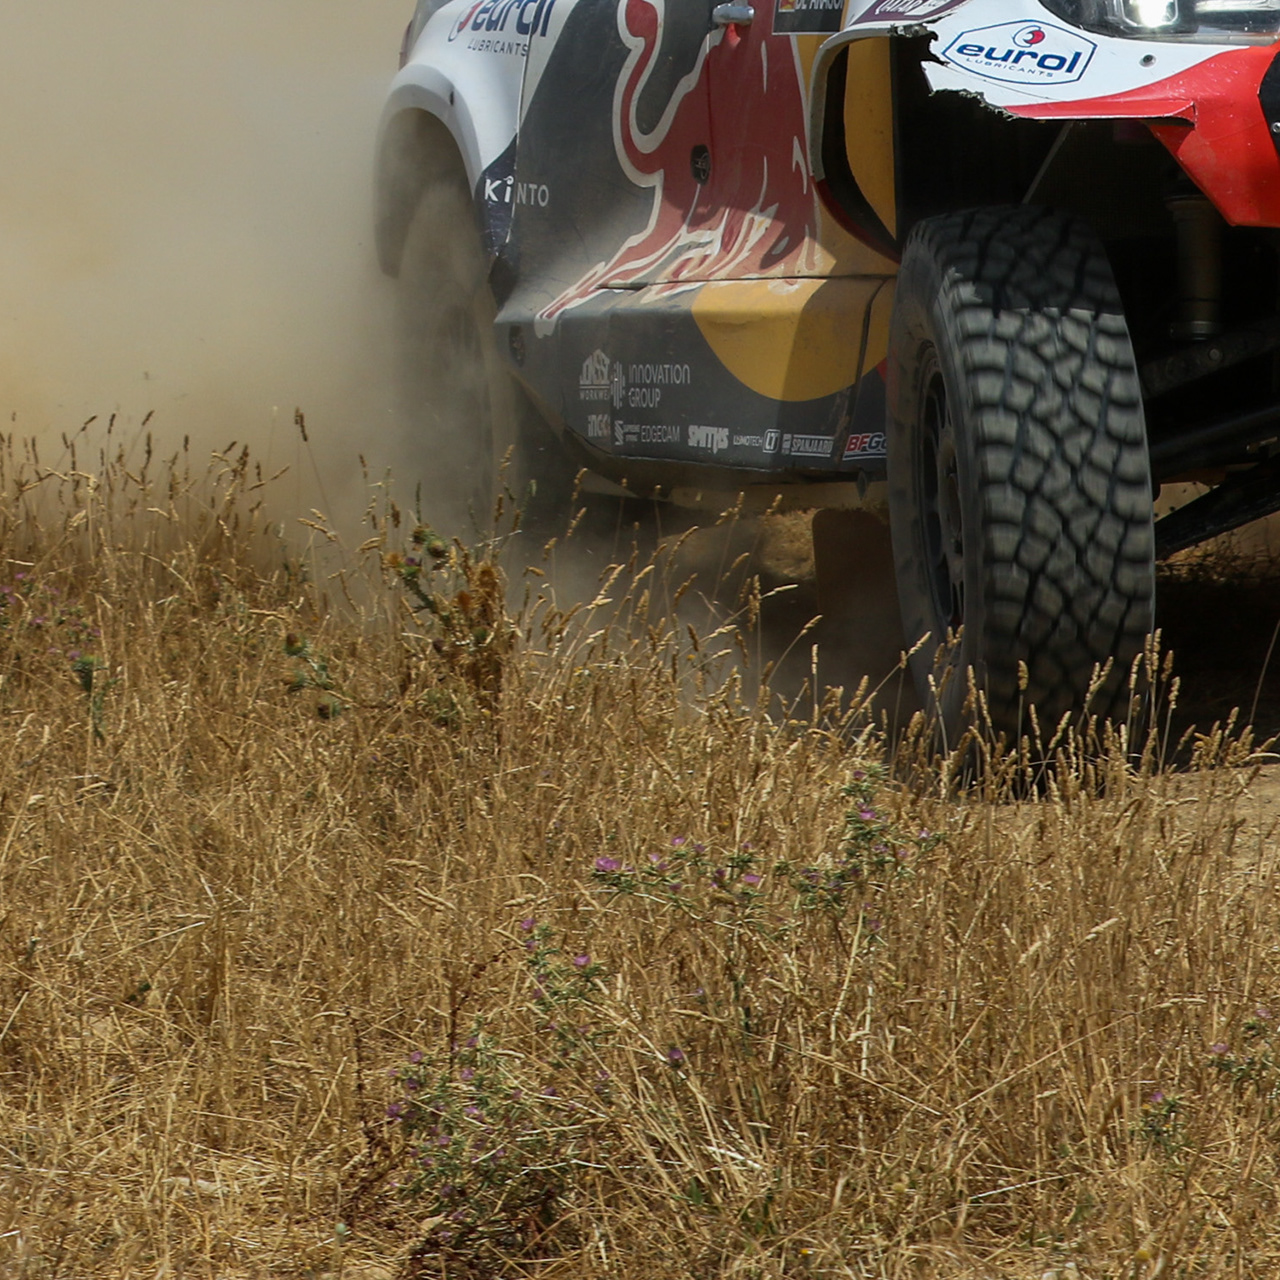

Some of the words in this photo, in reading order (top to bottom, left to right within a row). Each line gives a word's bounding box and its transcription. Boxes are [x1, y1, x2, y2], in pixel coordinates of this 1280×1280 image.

[467, 38, 529, 58] LUBRICANTS
[956, 43, 1083, 74] eurol
[965, 57, 1054, 78] LUBRICANTS
[628, 387, 661, 408] GROUP
[641, 425, 680, 442] EDGECAM
